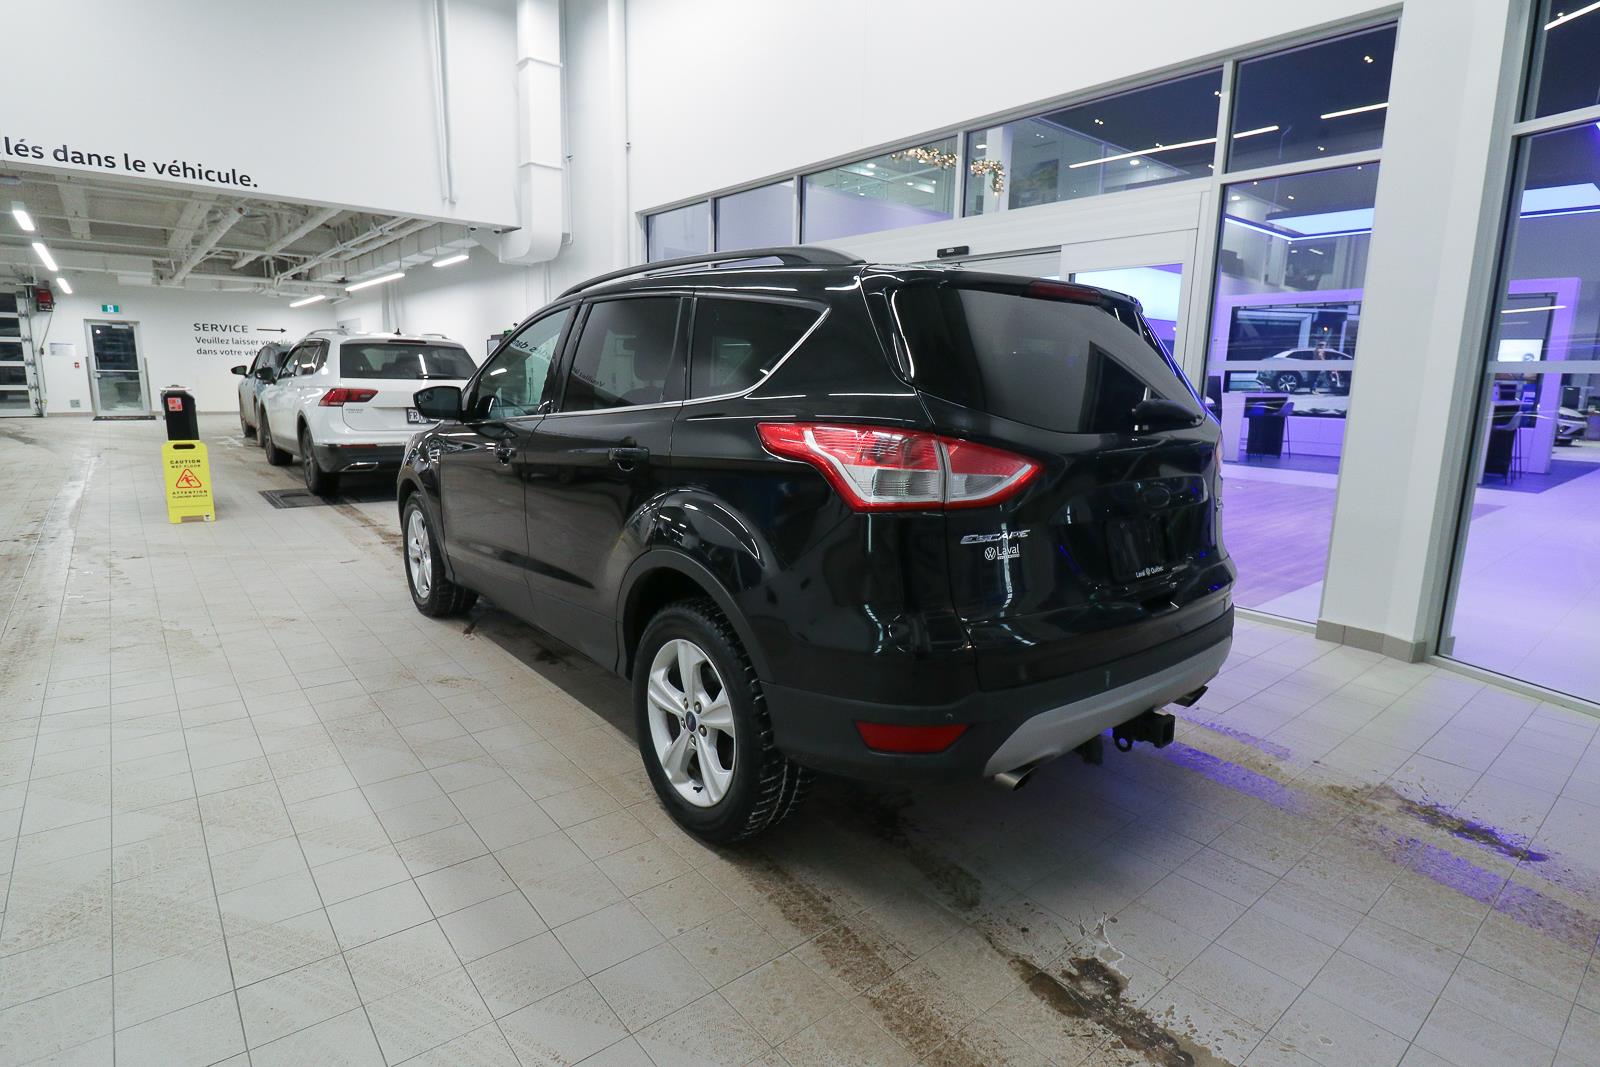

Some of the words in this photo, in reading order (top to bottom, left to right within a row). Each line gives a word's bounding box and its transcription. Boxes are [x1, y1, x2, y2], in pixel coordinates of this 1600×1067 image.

[1, 136, 45, 160] lés
[53, 144, 116, 169] dans
[124, 153, 146, 173] le
[153, 159, 258, 188] véhicule.
[193, 322, 249, 334] SERVICE
[195, 336, 230, 345] Veuillez
[232, 337, 259, 346] laisser
[196, 347, 218, 356] dans
[220, 348, 242, 356] votre
[996, 543, 1020, 556] Laval
